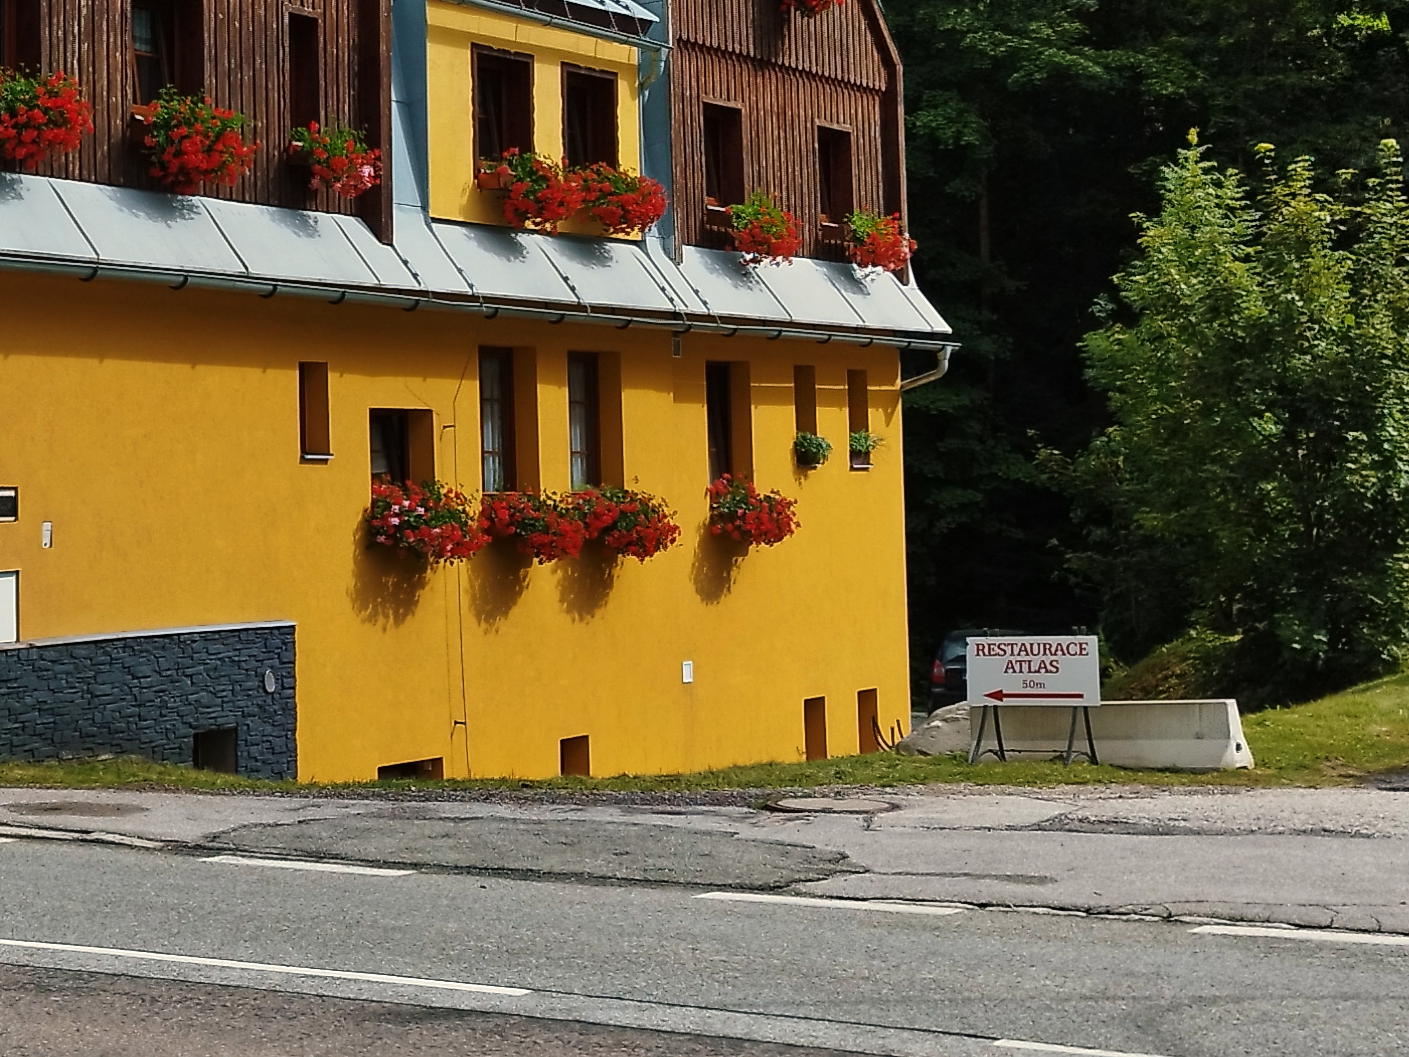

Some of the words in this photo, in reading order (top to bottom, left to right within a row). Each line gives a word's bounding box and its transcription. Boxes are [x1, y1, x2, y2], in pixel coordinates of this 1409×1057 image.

[974, 642, 1090, 657] RESTAURACE
[1003, 660, 1060, 674] ATLAS
[1022, 680, 1046, 689] 50m
